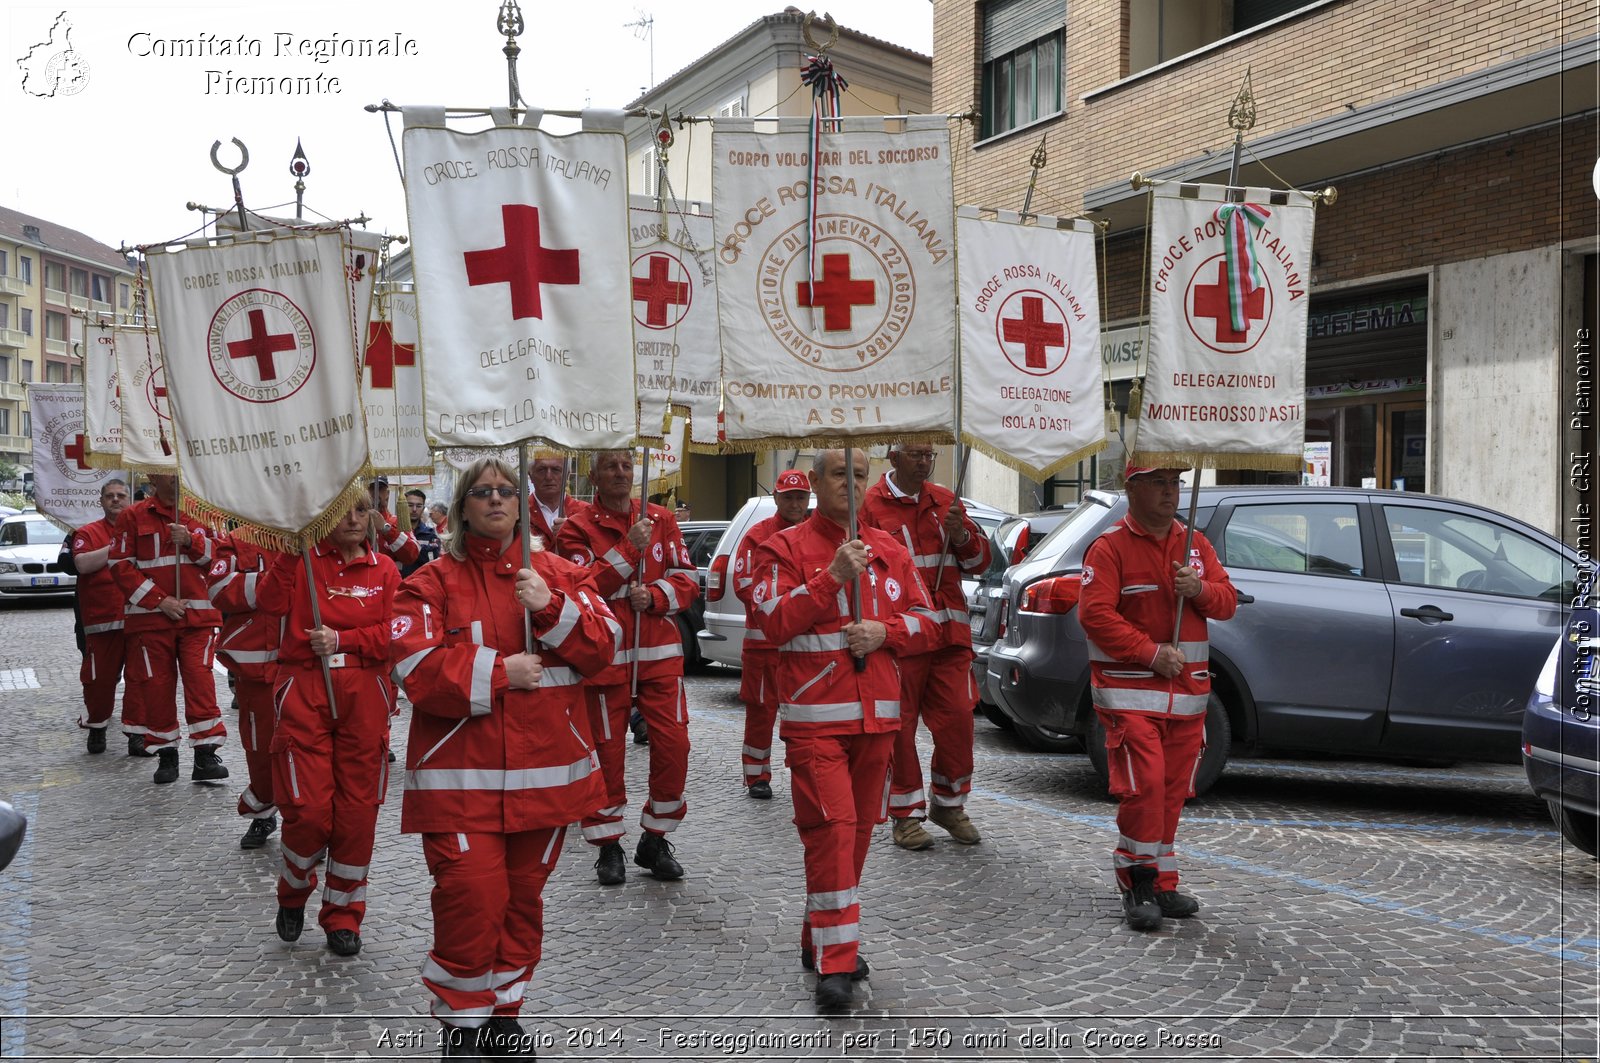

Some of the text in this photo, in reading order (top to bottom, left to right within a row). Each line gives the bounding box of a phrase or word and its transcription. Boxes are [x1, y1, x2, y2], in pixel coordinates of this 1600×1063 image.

[423, 147, 611, 190] CROCE ROSSA ITALIANA
[728, 145, 939, 168] CORPO VOLOTARI DEL SOCCORSO
[719, 196, 777, 266] CROCE
[864, 182, 949, 266] ITALIANA
[184, 258, 320, 291] CROCE ROSSA ITALIANA
[1154, 221, 1305, 302] CROCE ROS ITALIANA
[761, 219, 911, 363] CONVENZIONE DI INEVRA 22 AGOSTO 1864
[974, 264, 1086, 322] CROCE ROSSA ITALIANA
[209, 291, 255, 363] CONVENZIONE
[282, 300, 313, 352] GINEVRA
[1306, 302, 1416, 338] HEEMA
[480, 338, 573, 369] DELEGAZIONE
[636, 341, 680, 358] GRUPPO
[1101, 339, 1143, 365] OUSE
[287, 364, 310, 390] 1864
[526, 368, 541, 380] DI
[653, 360, 665, 370] DI
[727, 375, 951, 400] COMITATO PROVINCIALE
[1000, 386, 1071, 405] DELEGAZIONE
[439, 398, 535, 435] CASTELLO
[806, 407, 882, 425] ASTI
[1034, 403, 1042, 412] DI
[1148, 403, 1300, 421] MONTEGROSSO D'ASTI
[39, 411, 65, 445] CROCE
[373, 427, 421, 439] DAMANO
[1001, 415, 1072, 432] ISOLA D'ASTI
[186, 431, 278, 458] DELEGAZIONE
[263, 461, 303, 478] 1982
